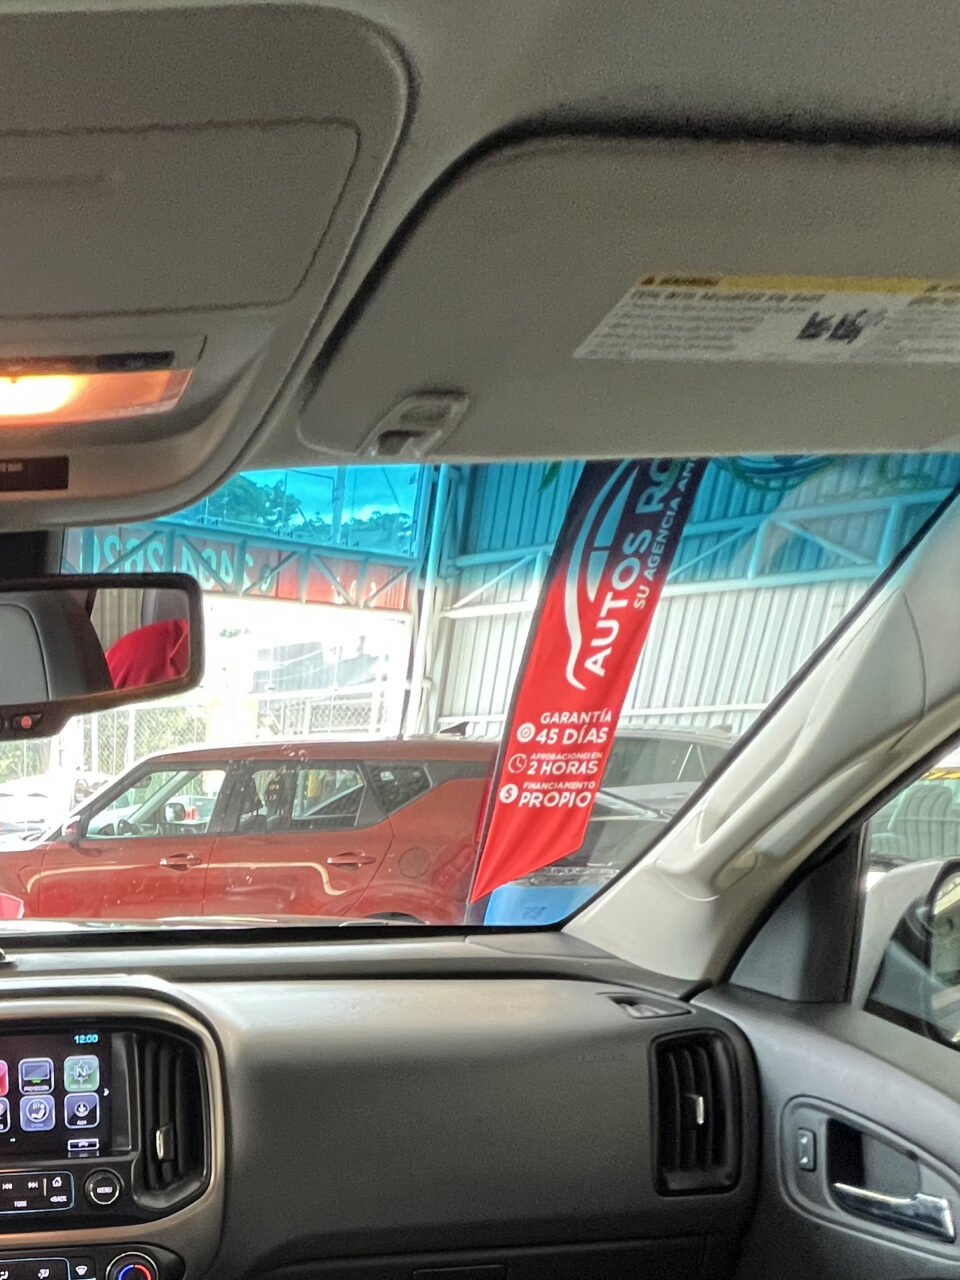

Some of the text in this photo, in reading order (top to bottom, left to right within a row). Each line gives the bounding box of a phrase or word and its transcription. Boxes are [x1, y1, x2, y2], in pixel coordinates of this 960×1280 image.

[633, 585, 650, 609] SU
[643, 497, 682, 581] AGENCIA
[584, 529, 652, 677] AUTOS
[540, 707, 612, 724] GARANTÍA
[535, 725, 609, 745] 45 DÍAS
[527, 760, 599, 775] 2 HORAS
[522, 781, 596, 789] FINANCIAMIENTO
[518, 791, 592, 808] PROPIO
[74, 1034, 99, 1043] 12:00
